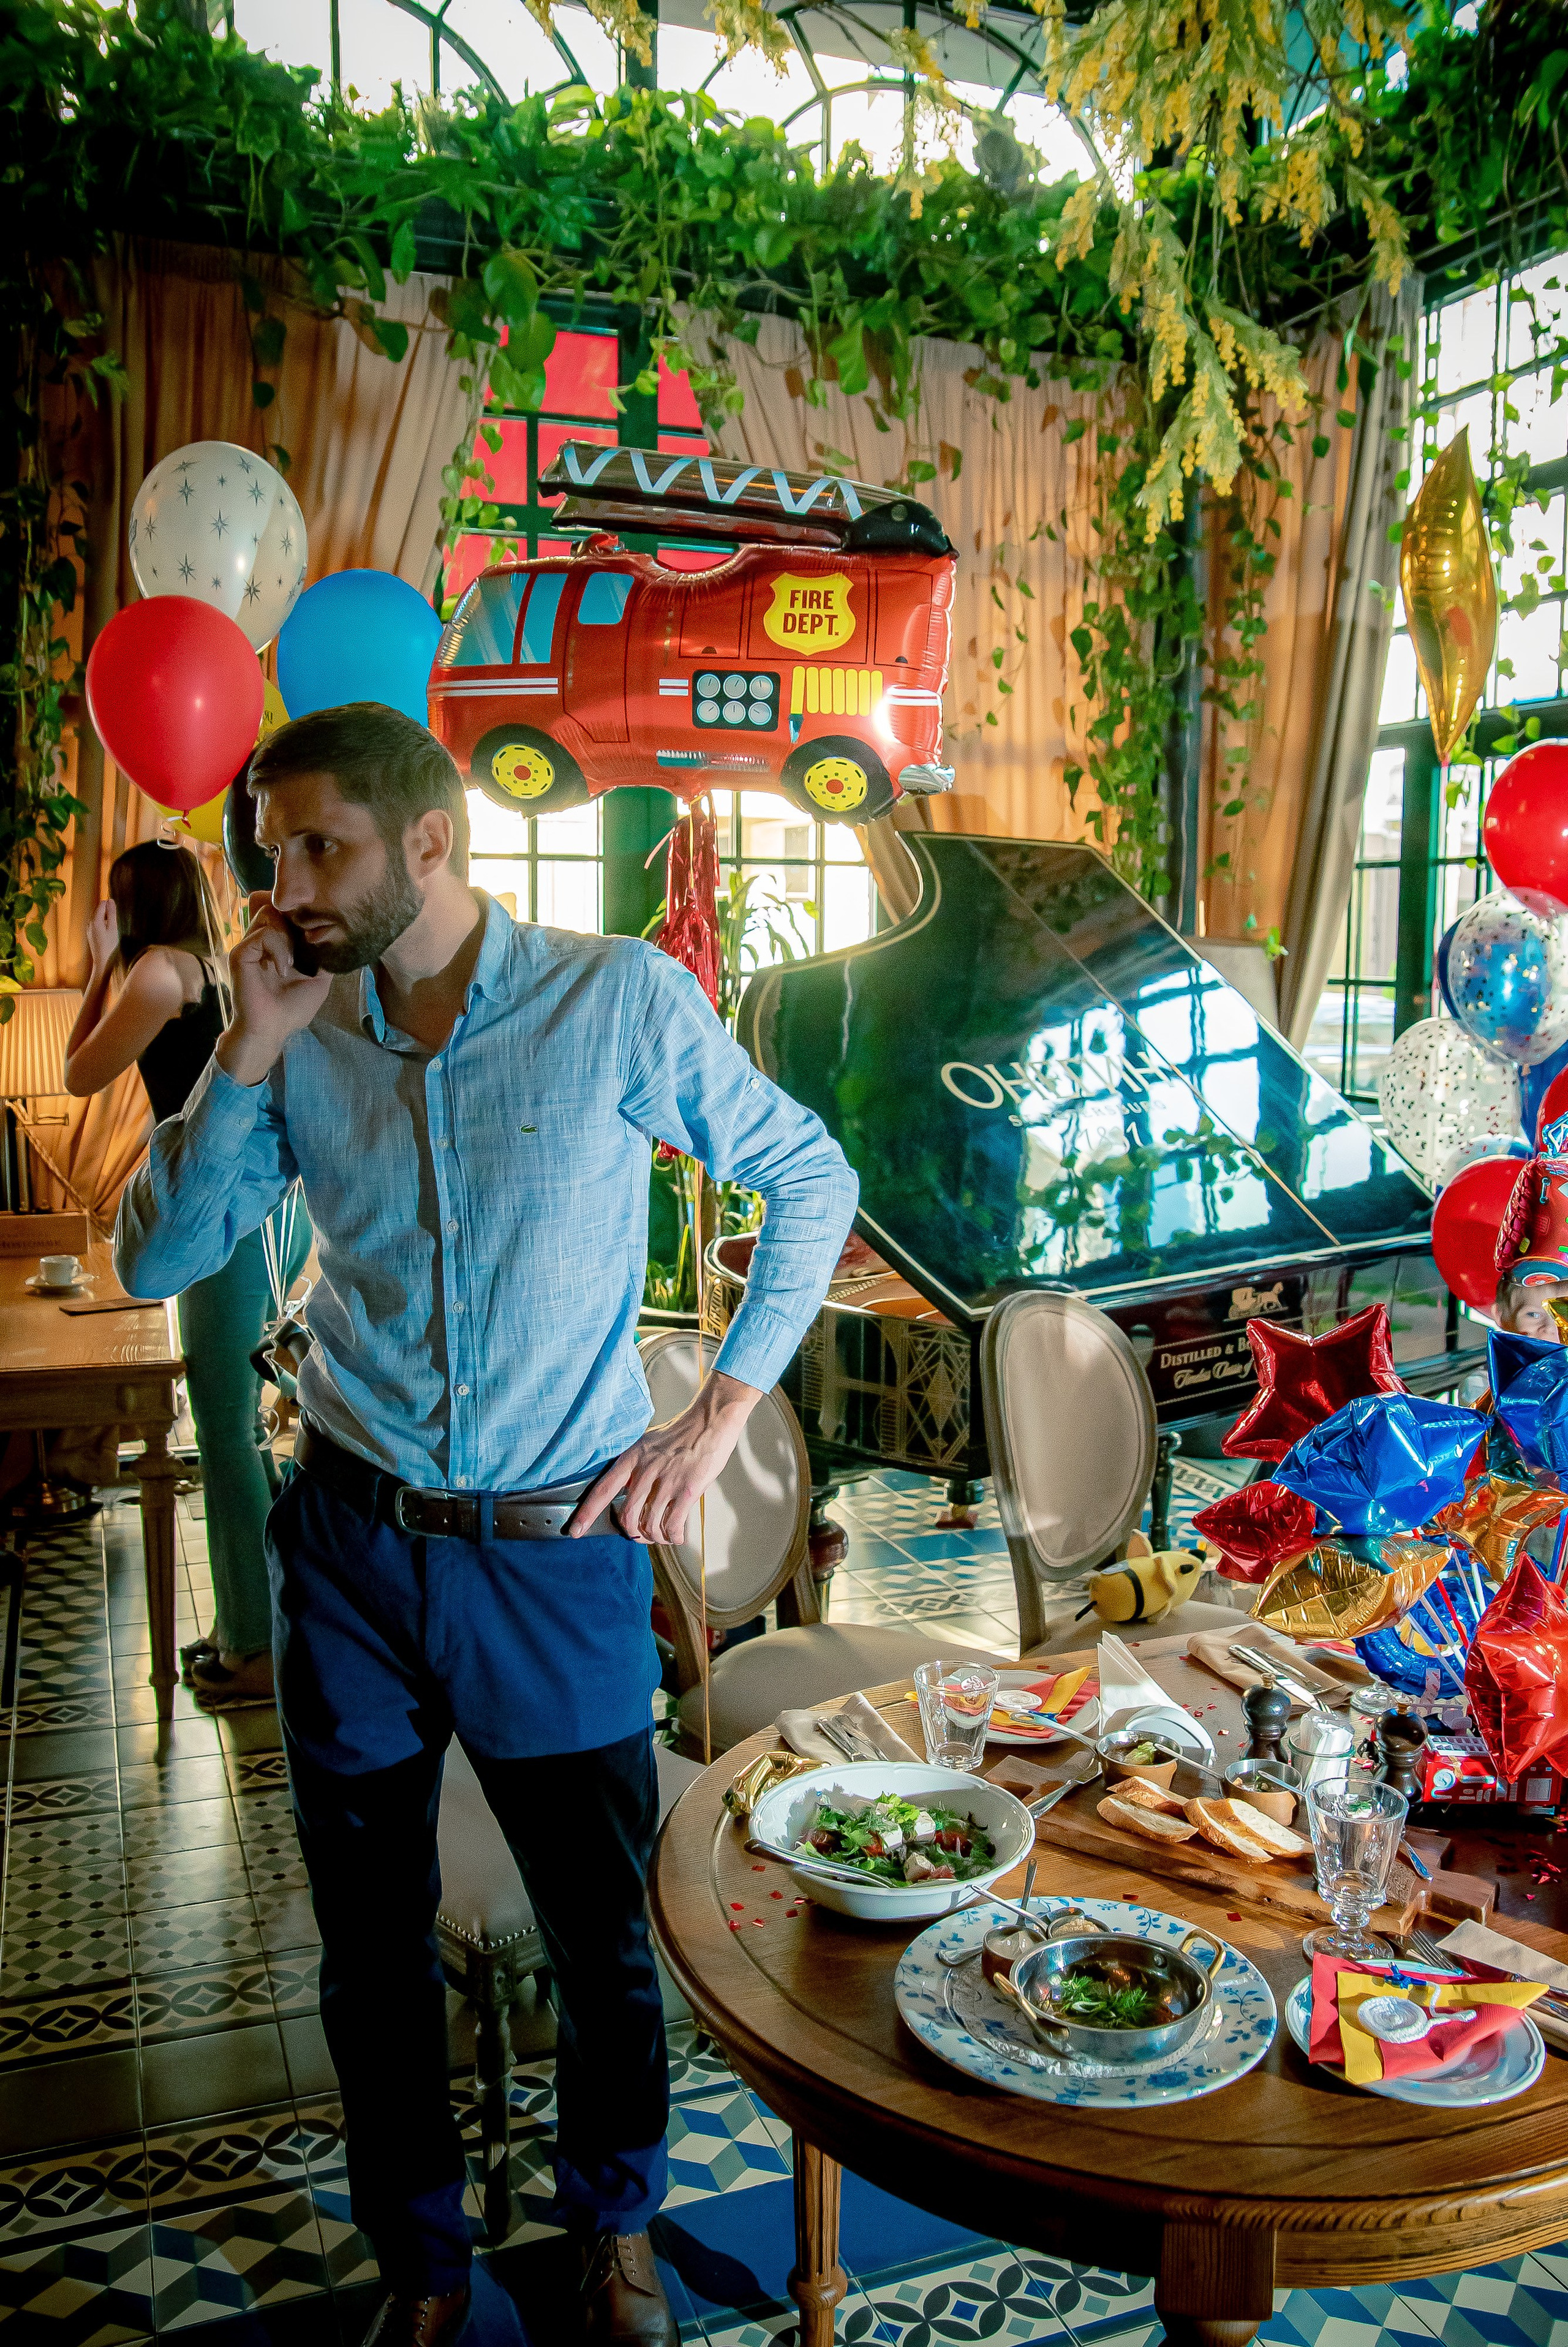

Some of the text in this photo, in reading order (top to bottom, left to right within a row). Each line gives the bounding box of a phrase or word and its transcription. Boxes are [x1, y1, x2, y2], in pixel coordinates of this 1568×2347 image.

[790, 589, 834, 610] FIRE
[783, 612, 839, 636] DEPT.
[1225, 1344, 1234, 1355] &
